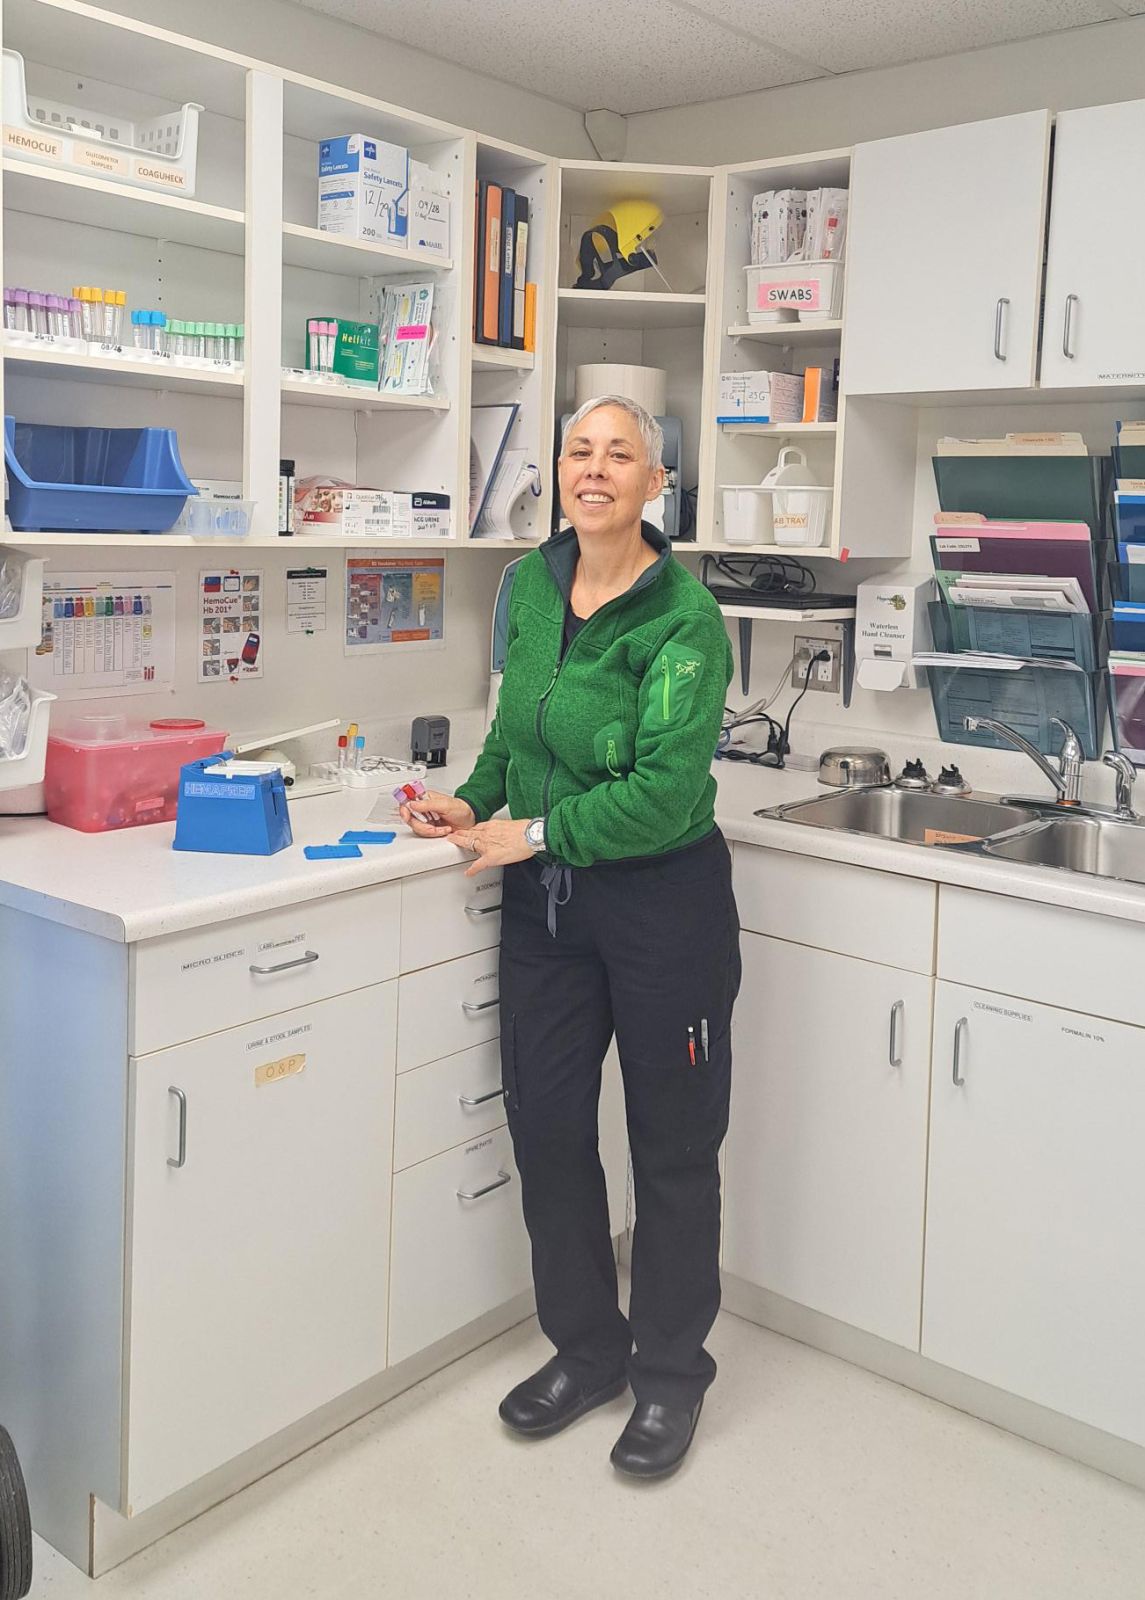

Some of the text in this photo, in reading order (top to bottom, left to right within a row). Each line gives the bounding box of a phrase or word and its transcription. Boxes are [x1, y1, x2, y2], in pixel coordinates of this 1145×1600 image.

[8, 133, 57, 155] HEMOCUE
[138, 167, 184, 185] COAGUHECK
[363, 171, 382, 184] Safety
[383, 177, 403, 188] Lancets
[362, 227, 376, 236] 200
[769, 289, 812, 300] SWABS
[786, 517, 806, 525] TRAY
[203, 597, 238, 605] HemoCue
[203, 607, 214, 615] Hb
[182, 949, 245, 971] MICRO SLIDES
[974, 1001, 1031, 1021] CLEANING SUPPLIES
[287, 1024, 312, 1037] SAMPLES
[1061, 1026, 1105, 1042] FORMALIN 10%
[265, 1059, 296, 1078] O & P
